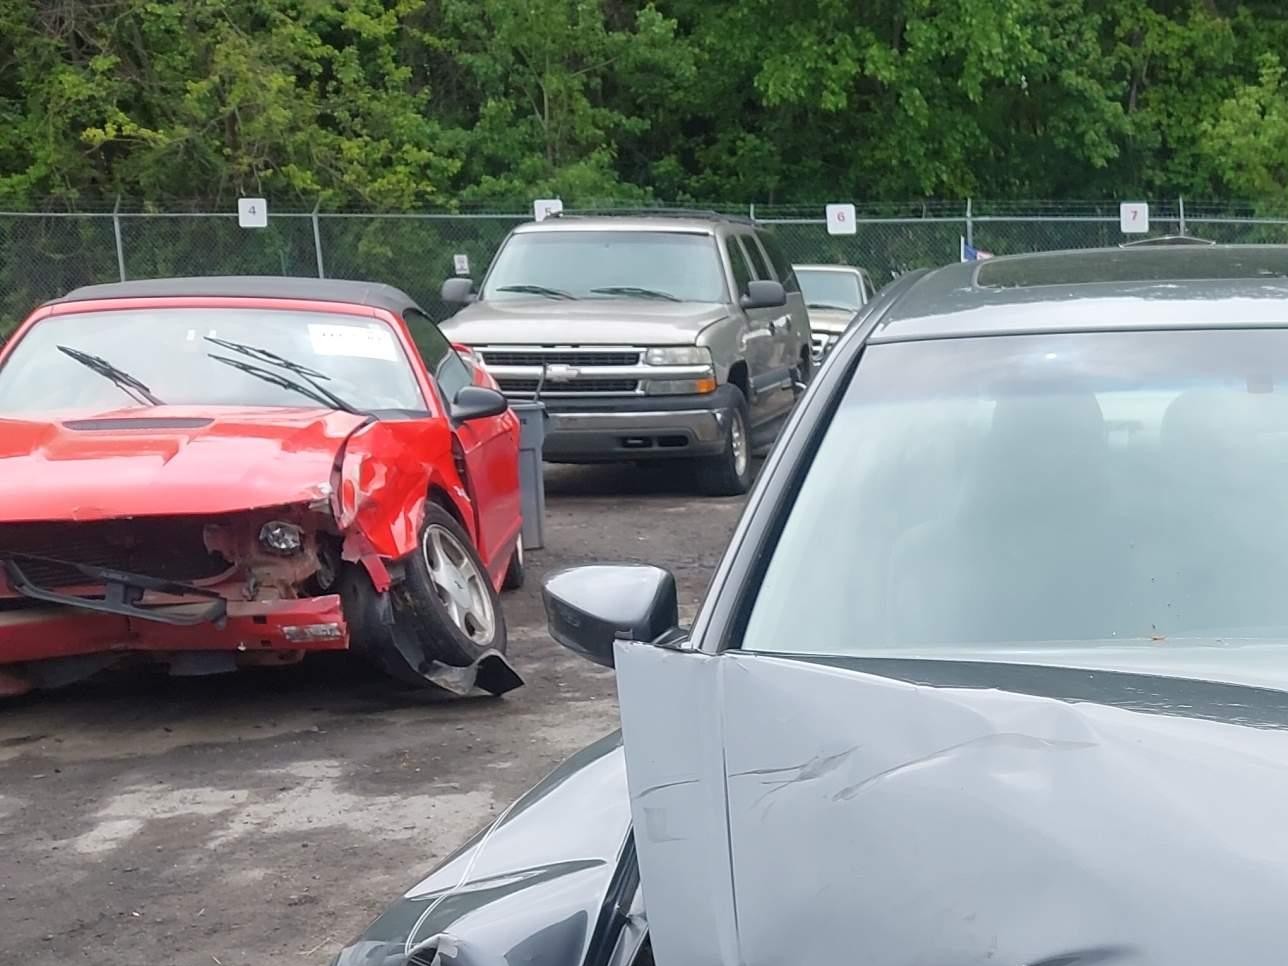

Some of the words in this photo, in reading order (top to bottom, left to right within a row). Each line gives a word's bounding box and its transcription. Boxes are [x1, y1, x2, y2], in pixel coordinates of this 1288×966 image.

[247, 205, 256, 216] 4
[1130, 210, 1138, 221] 7
[837, 211, 845, 222] 6
